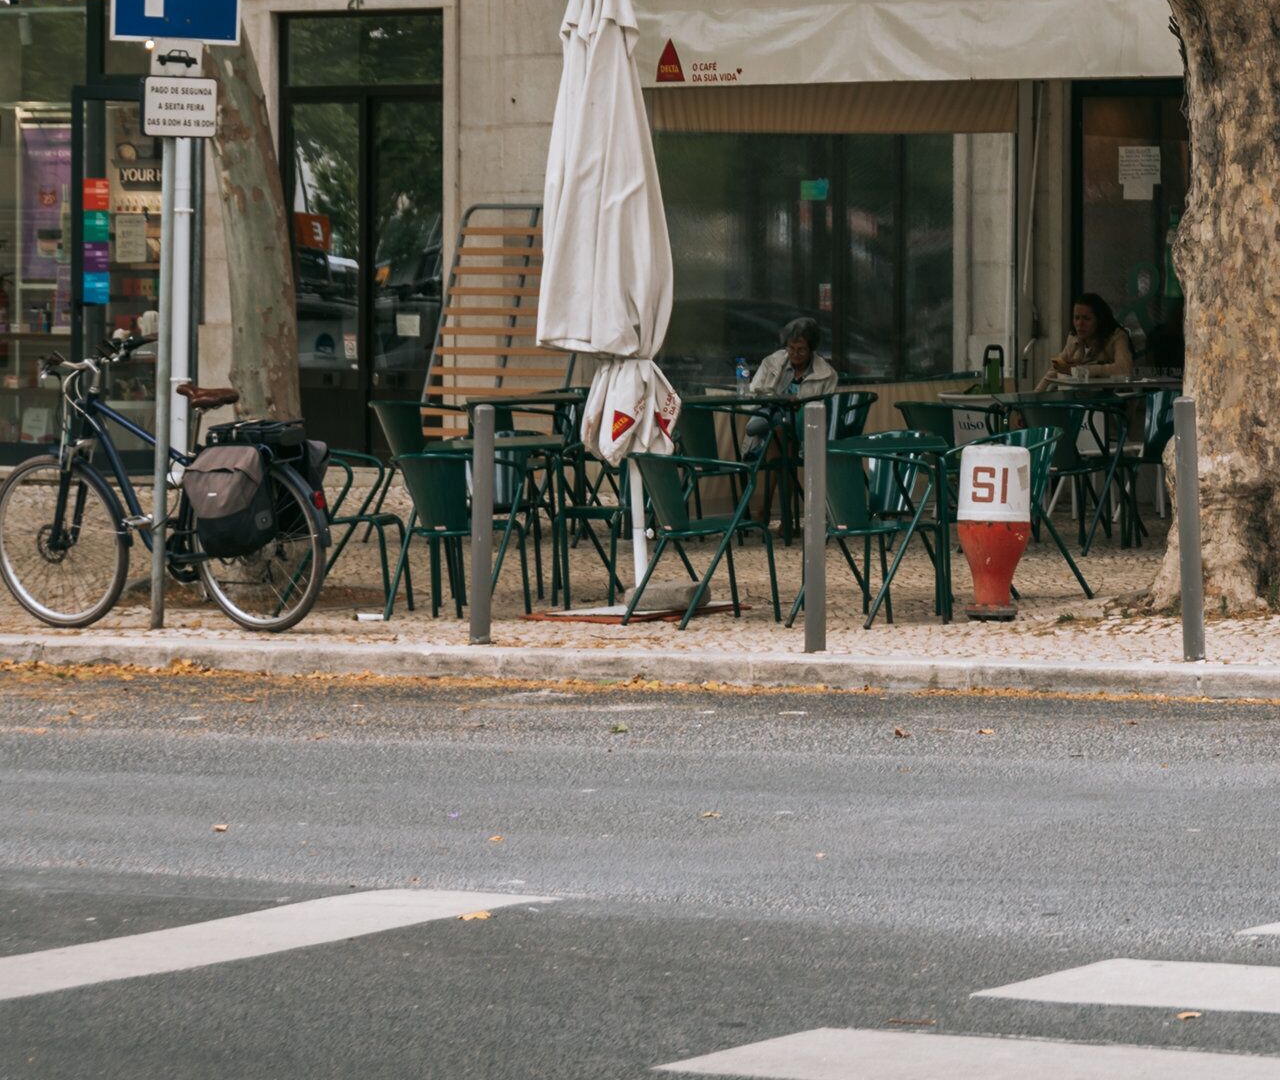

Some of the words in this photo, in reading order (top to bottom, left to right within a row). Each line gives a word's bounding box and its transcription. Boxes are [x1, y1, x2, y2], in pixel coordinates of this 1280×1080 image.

[660, 64, 679, 73] DELTA
[692, 63, 698, 71] O
[699, 61, 717, 71] CAFÉ
[692, 74, 702, 82] DA
[703, 73, 718, 82] SUA
[719, 73, 738, 81] VIDA
[150, 85, 169, 94] PAGO
[170, 86, 179, 94] DE
[181, 86, 212, 96] SEGUNDA
[164, 102, 185, 111] SEXTA
[186, 103, 205, 111] FEIRA
[121, 168, 155, 182] YOUR
